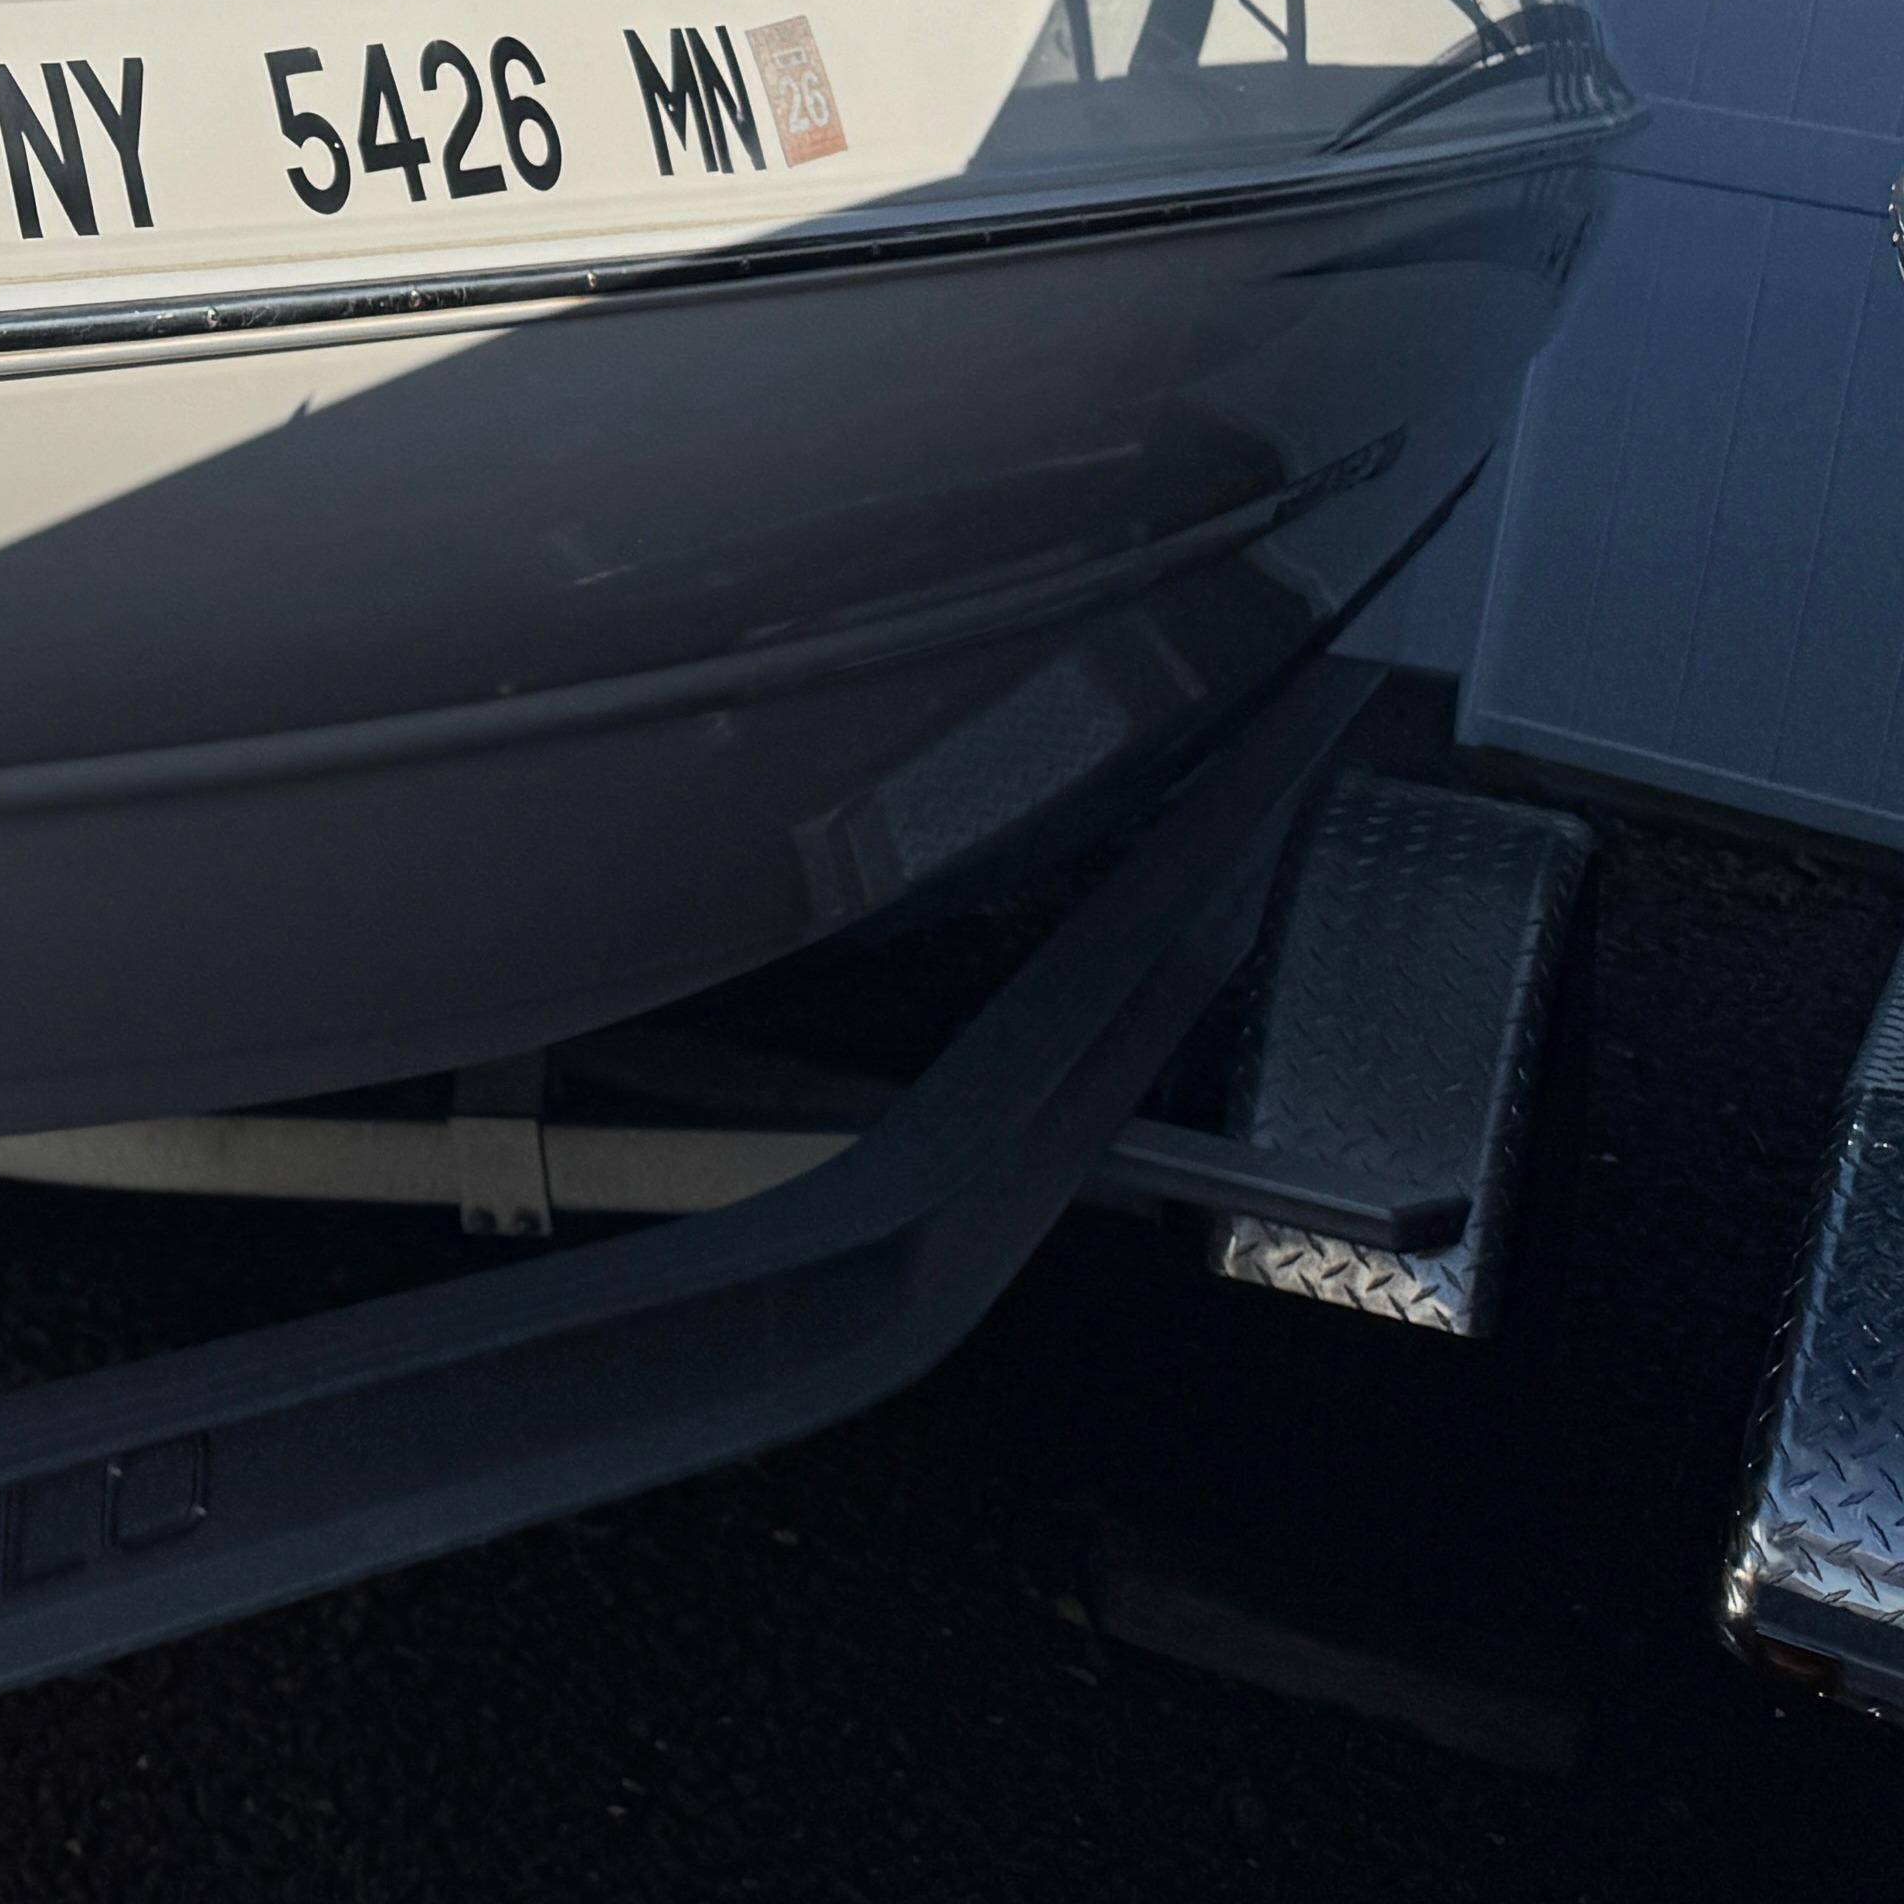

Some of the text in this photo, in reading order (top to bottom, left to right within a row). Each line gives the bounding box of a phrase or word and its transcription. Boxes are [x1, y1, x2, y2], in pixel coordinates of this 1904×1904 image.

[262, 35, 562, 215] 5426
[622, 24, 766, 176] MN
[779, 72, 830, 133] 26
